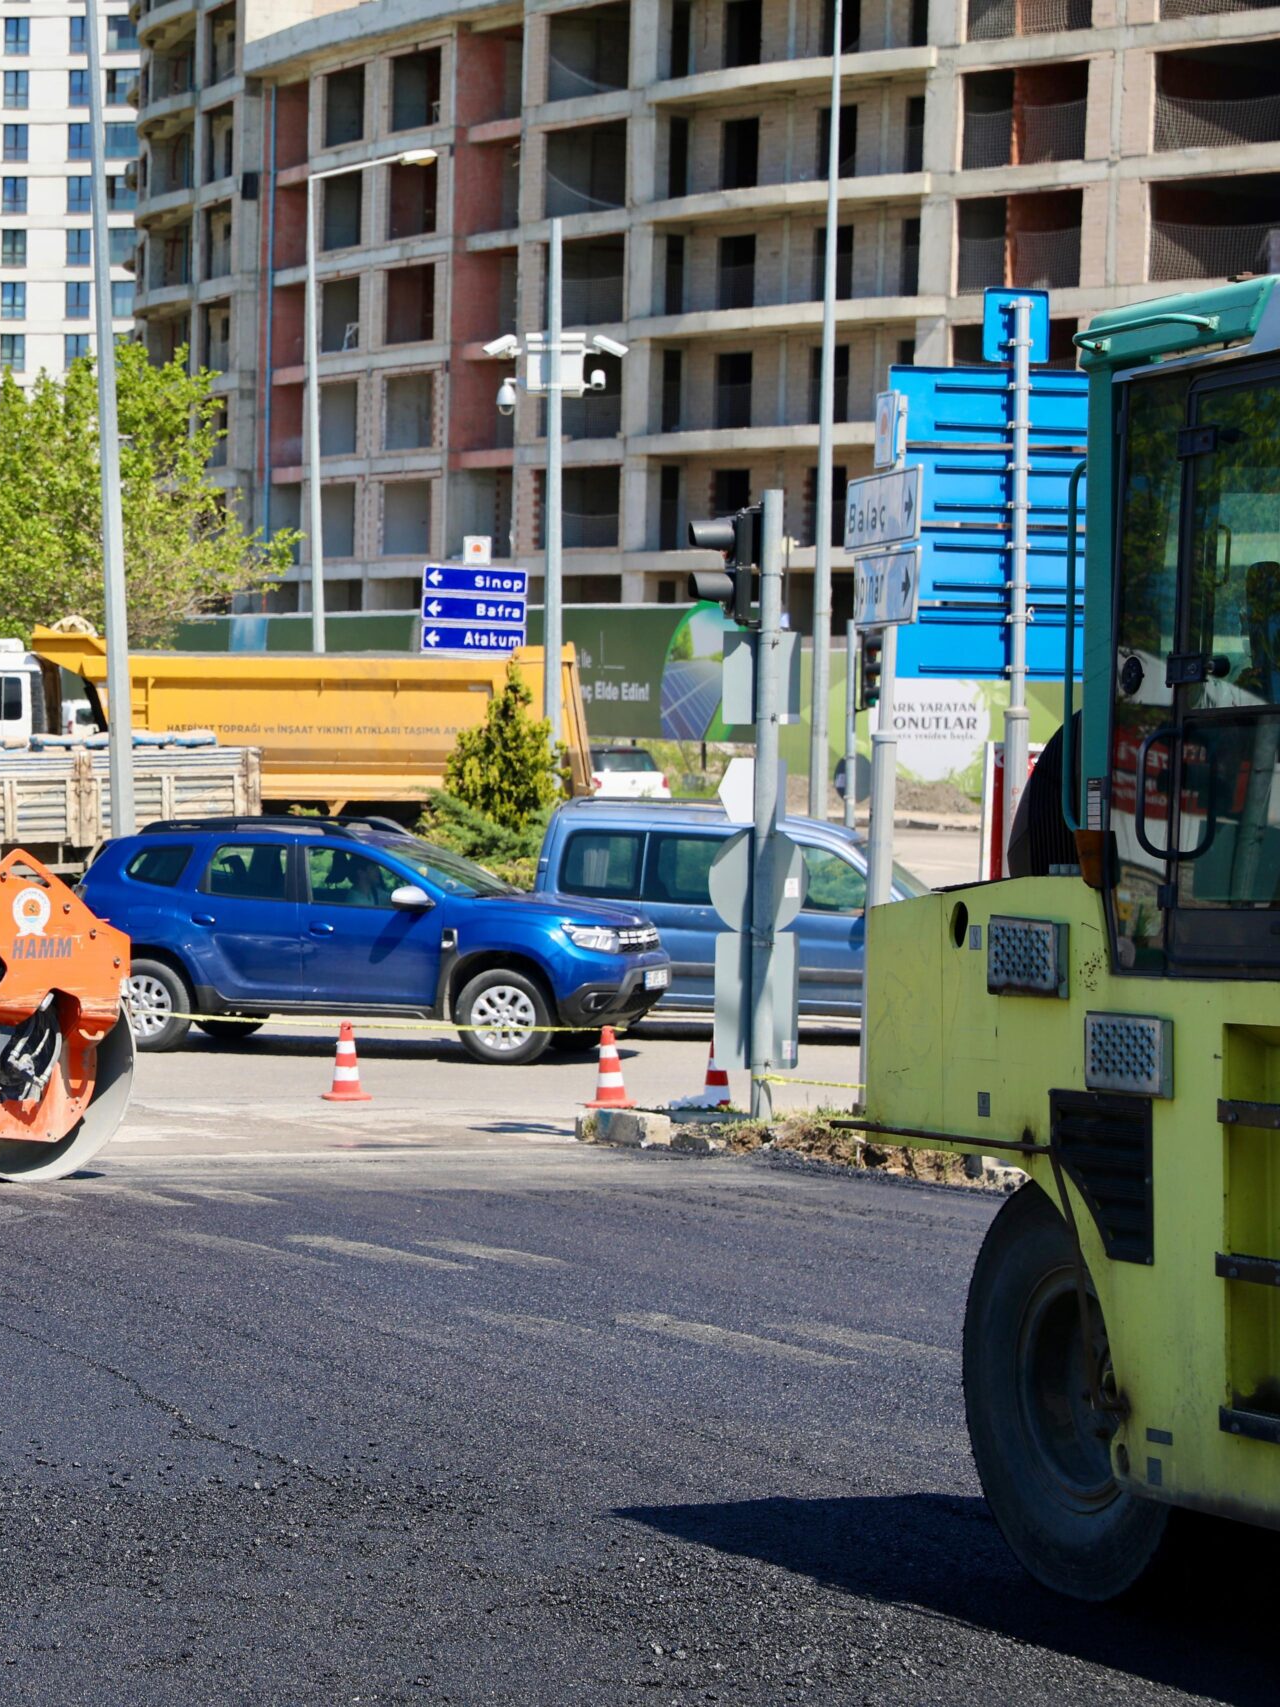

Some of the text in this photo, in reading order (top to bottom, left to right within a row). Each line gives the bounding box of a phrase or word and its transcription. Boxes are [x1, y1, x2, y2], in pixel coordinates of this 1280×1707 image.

[848, 499, 886, 535] Balaç
[474, 575, 524, 592] Sinop
[476, 603, 521, 619] Bafra
[463, 631, 521, 648] Atakum
[595, 681, 620, 701] Elde
[621, 682, 650, 702] Edin!
[892, 702, 977, 713] ARK YARATAN
[218, 723, 261, 734] TOPRAĞI
[263, 726, 276, 734] ve
[277, 722, 313, 736] İNŞAAT
[317, 725, 353, 735] YIKINTI
[355, 725, 401, 736] ATIKLARI
[404, 726, 441, 737] TAŞIMA
[893, 716, 978, 731] ONUTLAR
[12, 937, 73, 960] HAMM
